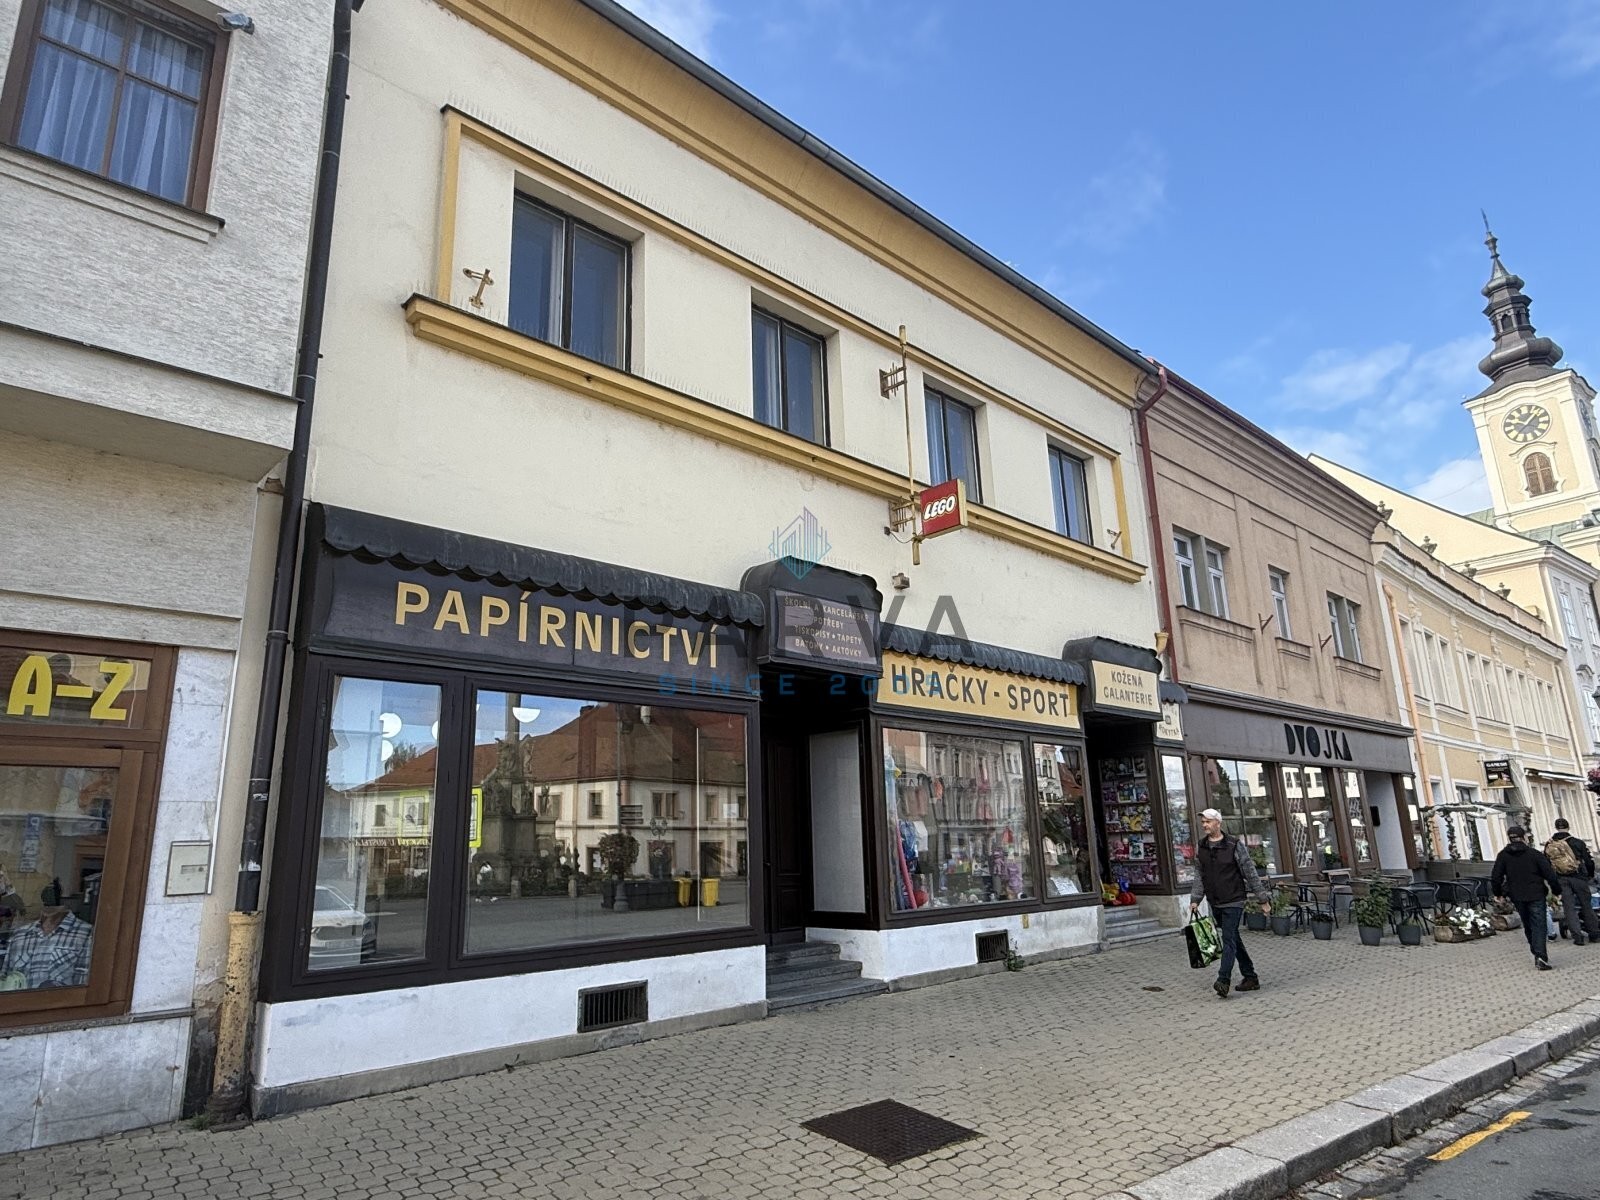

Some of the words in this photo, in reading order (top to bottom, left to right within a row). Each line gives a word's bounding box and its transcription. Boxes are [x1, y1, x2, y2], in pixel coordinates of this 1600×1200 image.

[923, 494, 957, 521] LEGO
[394, 580, 719, 669] PAPÍRNICTVÍ
[813, 615, 844, 630] POTŘEBY
[794, 624, 831, 639] TISKOPISY
[836, 633, 862, 645] TAPETY
[832, 645, 862, 657] AKTOVKY
[1110, 670, 1143, 687] KOŽENÁ
[891, 663, 988, 706] HRAČKY
[1007, 683, 1069, 718] SPORT
[1103, 686, 1153, 706] GALANTERIE
[1284, 722, 1353, 761] DVOJKA
